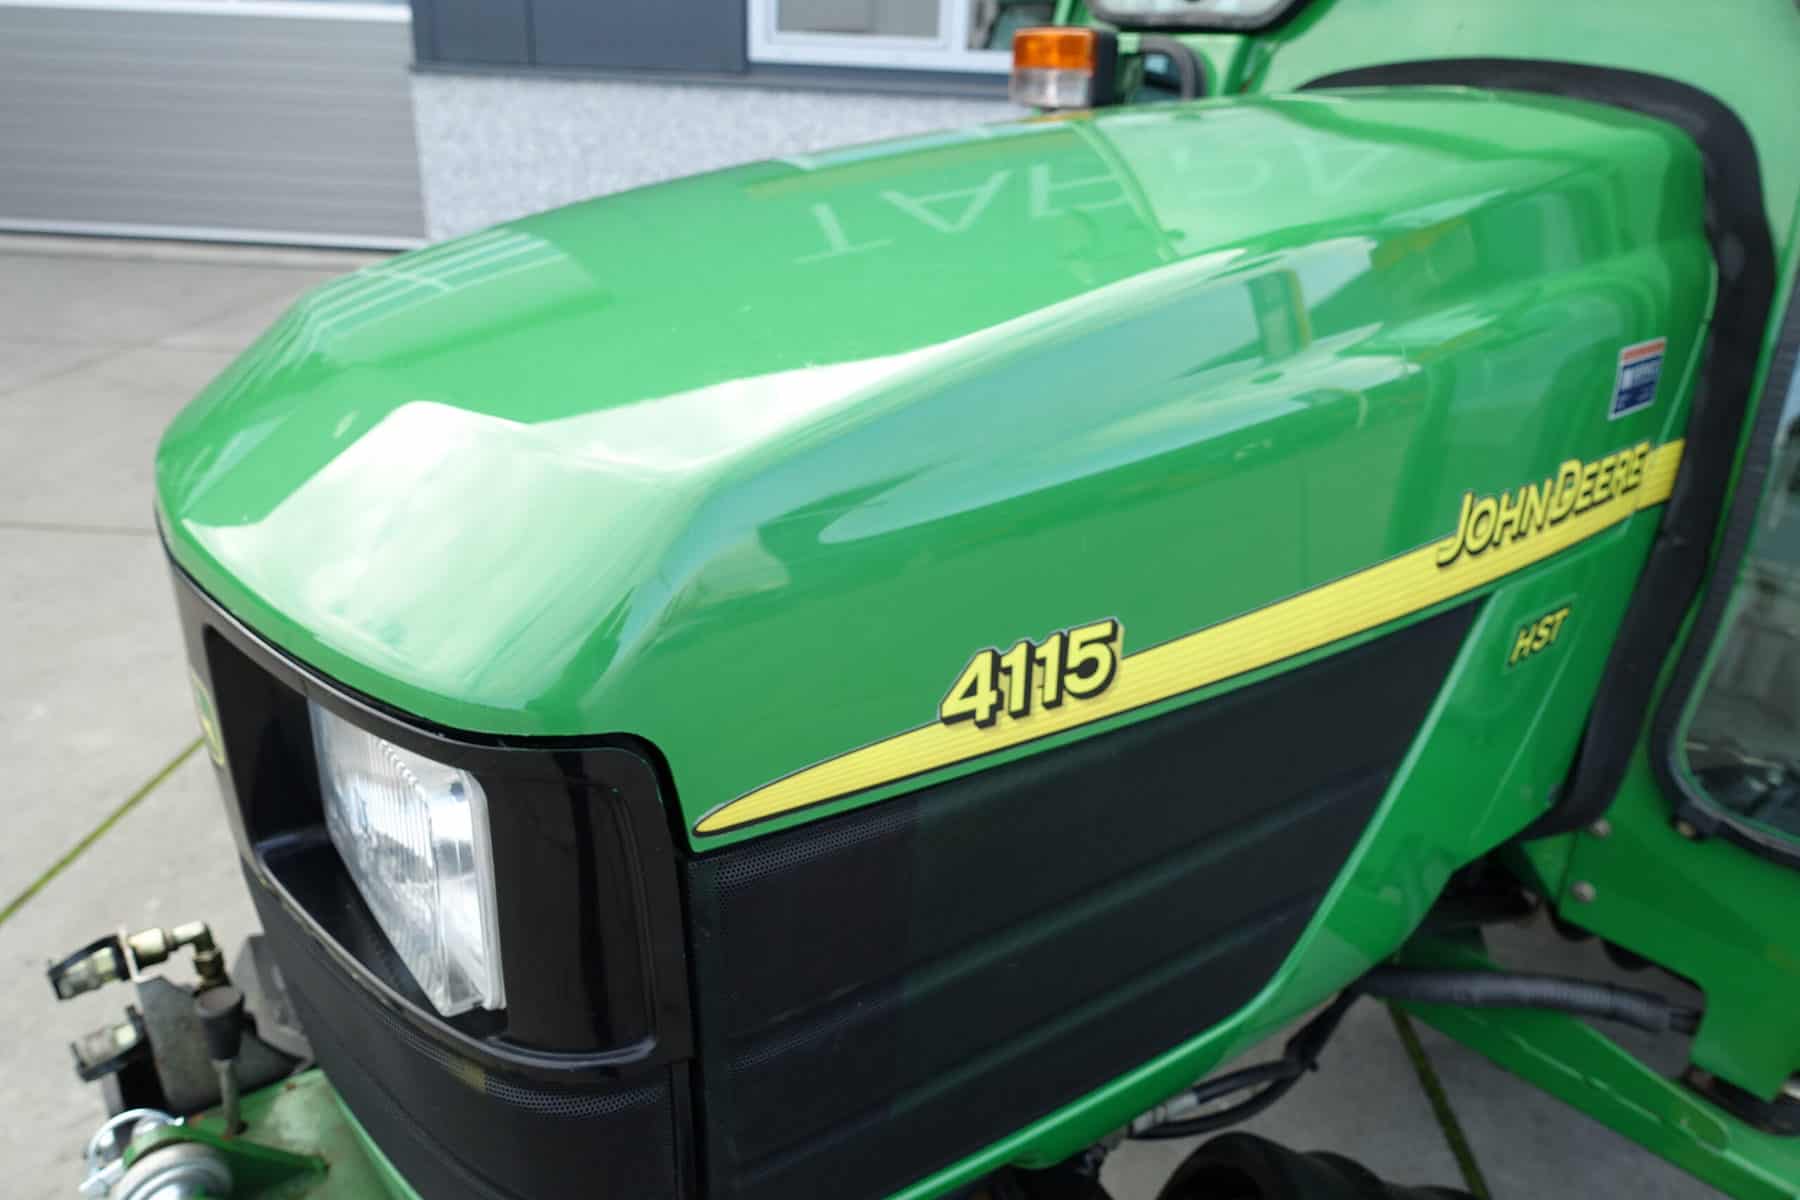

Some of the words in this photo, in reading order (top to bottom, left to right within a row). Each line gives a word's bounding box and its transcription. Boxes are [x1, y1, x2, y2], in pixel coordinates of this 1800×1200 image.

[1437, 479, 1553, 568] JOHN
[1549, 442, 1650, 525] DEERE
[940, 618, 1119, 729] 4115
[1508, 605, 1570, 667] HST
